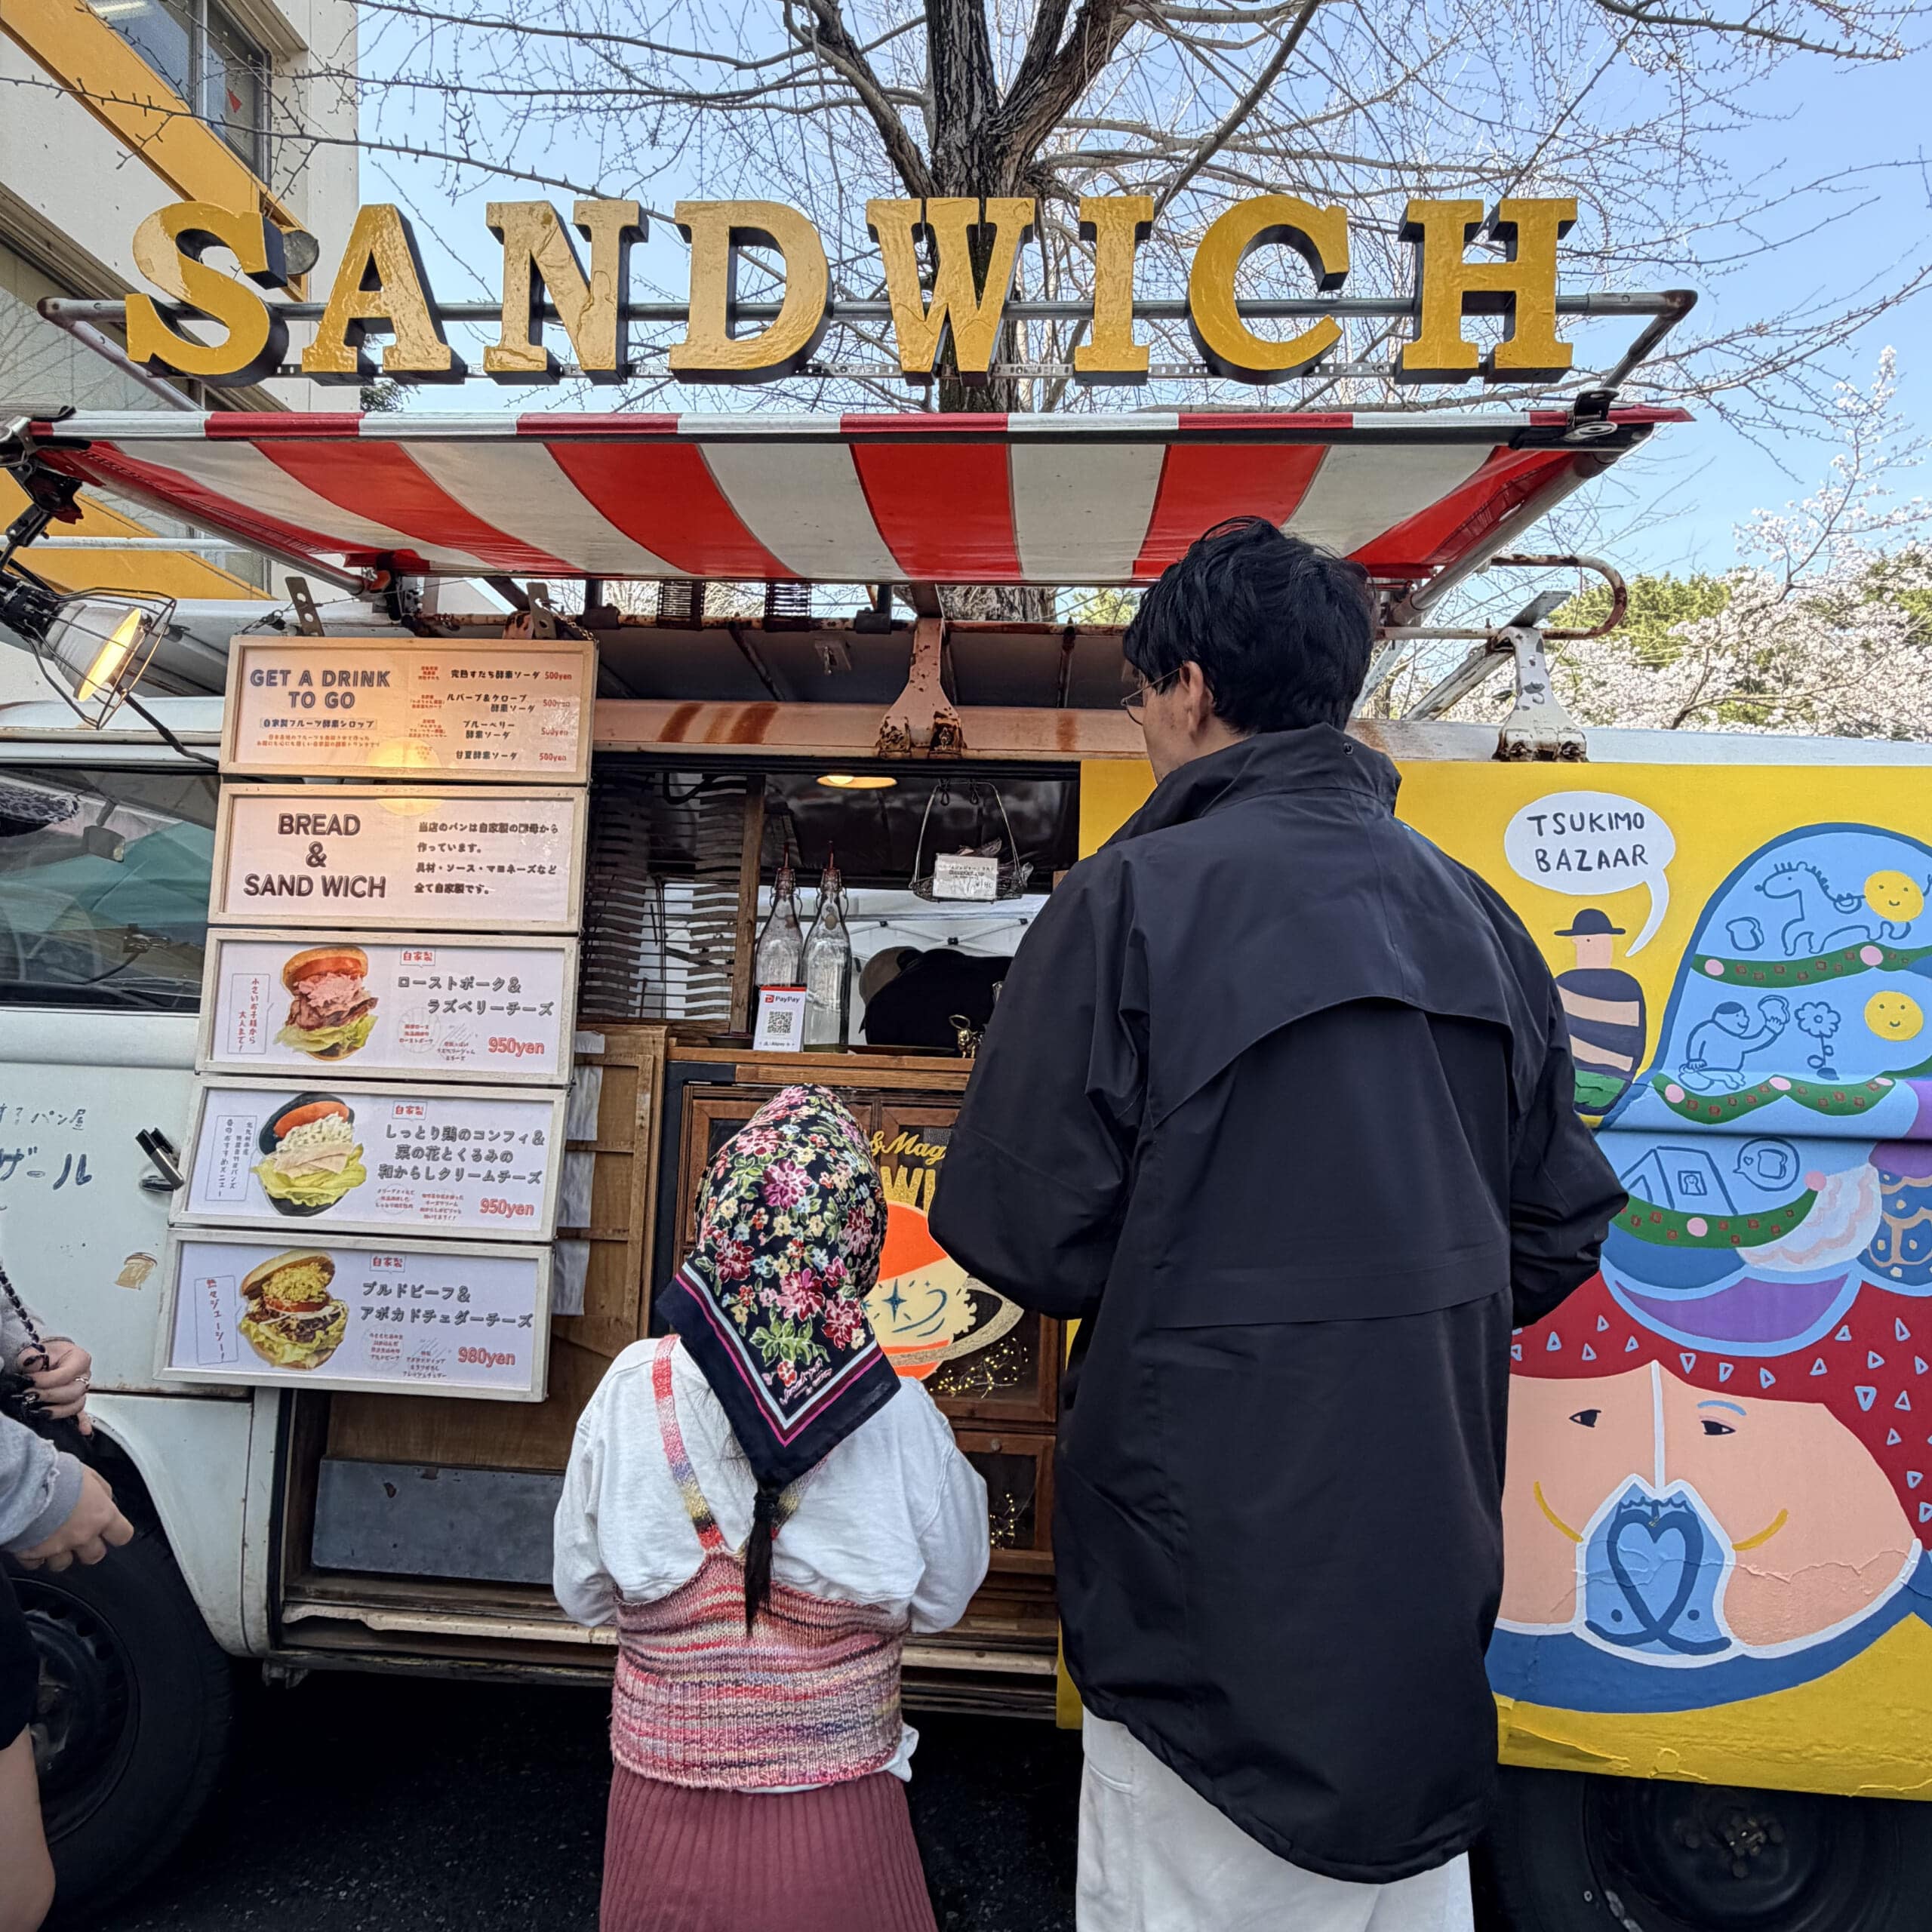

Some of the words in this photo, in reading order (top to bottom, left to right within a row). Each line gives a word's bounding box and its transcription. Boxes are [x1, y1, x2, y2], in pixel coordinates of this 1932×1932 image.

[126, 195, 1577, 386] SANDWICH
[250, 669, 291, 687] GET
[298, 670, 313, 687] A
[321, 669, 391, 688] DRINK
[545, 671, 573, 681] 500yen
[288, 691, 316, 709] TO
[325, 691, 355, 709] GO
[539, 752, 567, 761] 500yen
[278, 813, 361, 835] BREAD
[1527, 812, 1645, 836] TSUKIMO
[306, 841, 328, 868] &
[417, 841, 481, 854] 作っています。
[1535, 844, 1648, 872] BAZAAR
[416, 863, 557, 875] 具材・ソース・マヨネーズなど
[243, 873, 314, 897] SAND
[321, 875, 386, 898] WICH
[414, 882, 490, 894] 全て自家製です。
[403, 951, 432, 962] 自家製
[427, 998, 555, 1016] ラズベリーチーズ
[775, 995, 801, 1004] PayPay
[488, 1036, 545, 1057] 950yen
[395, 1105, 423, 1116] 自家製
[395, 1144, 514, 1162] 菜の花とくるみの
[377, 1164, 543, 1185] 和からしクリームチーズ
[479, 1196, 535, 1219] 950yen
[373, 1257, 403, 1268] 自家製
[361, 1306, 534, 1328] アボカドチェダーチーズ
[457, 1346, 516, 1367] 980yen
